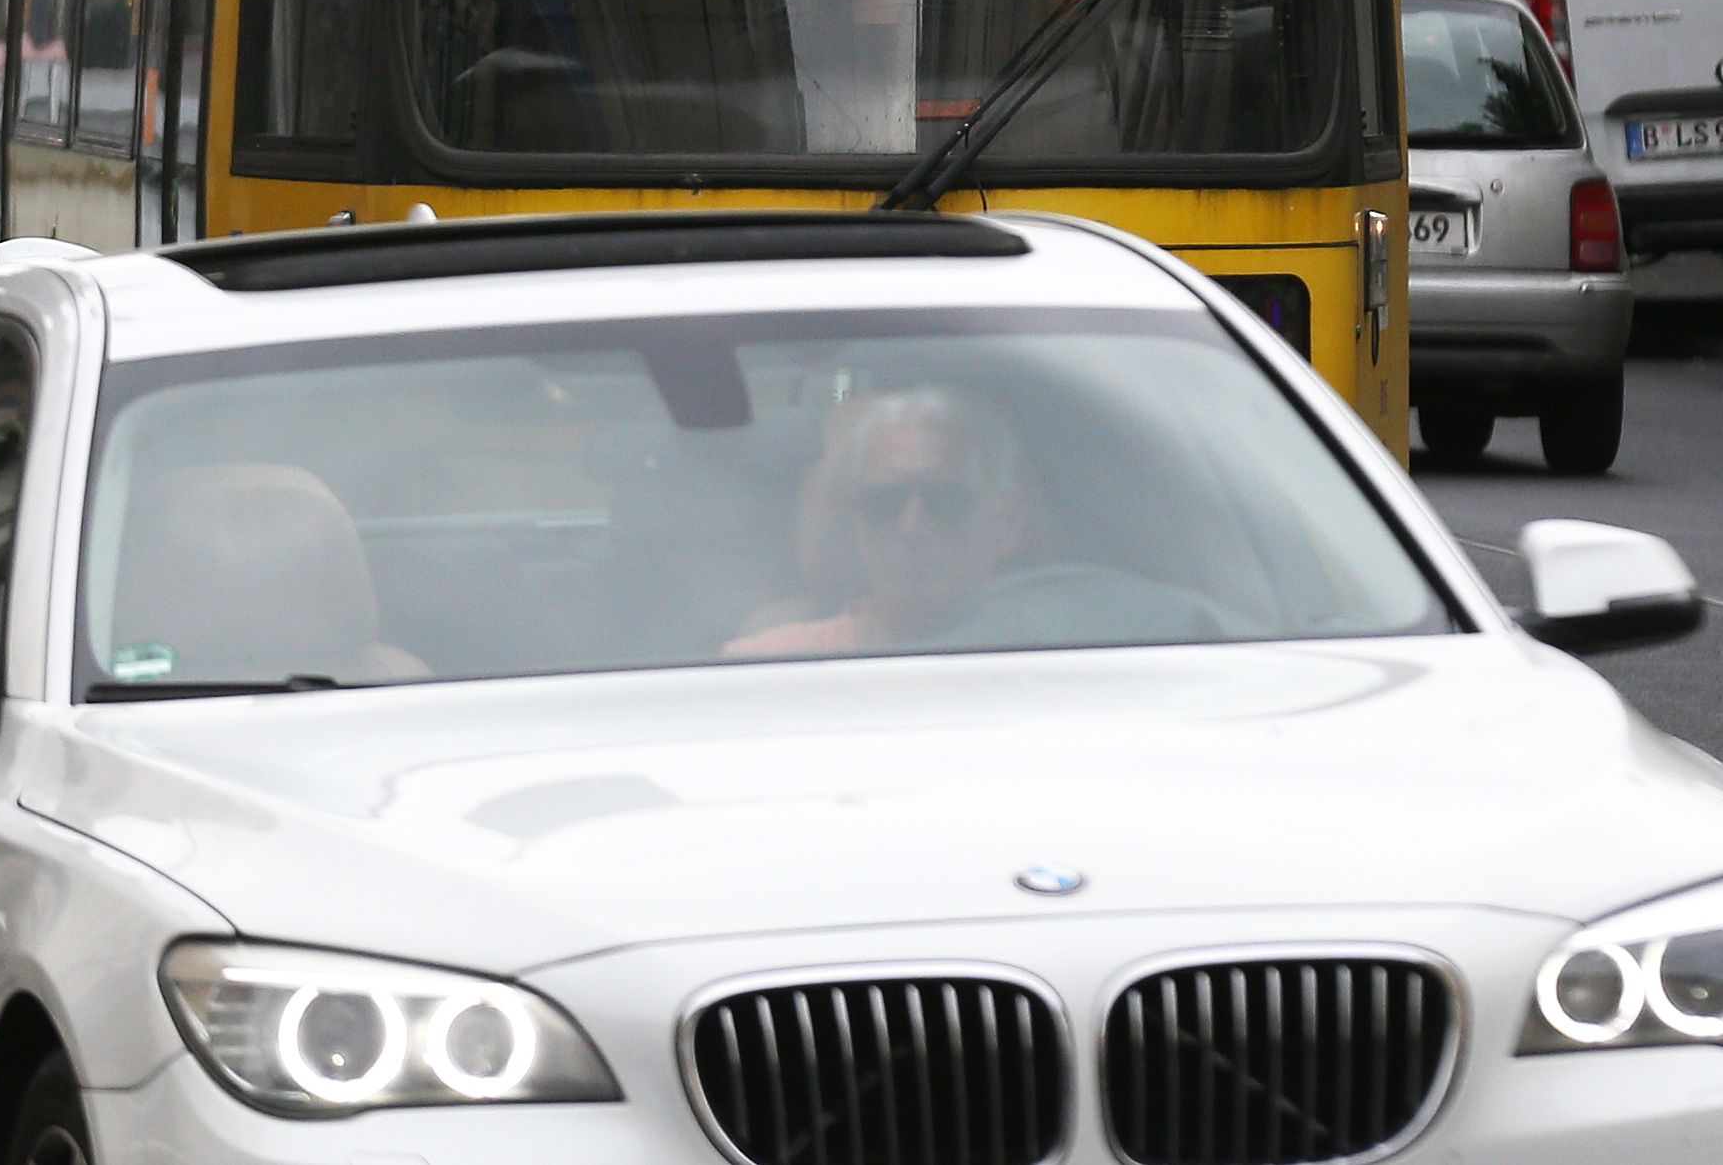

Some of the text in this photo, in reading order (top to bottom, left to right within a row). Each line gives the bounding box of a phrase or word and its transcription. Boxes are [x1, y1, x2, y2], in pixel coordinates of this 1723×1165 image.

[1644, 126, 1658, 148] B
[1677, 123, 1708, 147] LS
[1409, 214, 1450, 244] 69
